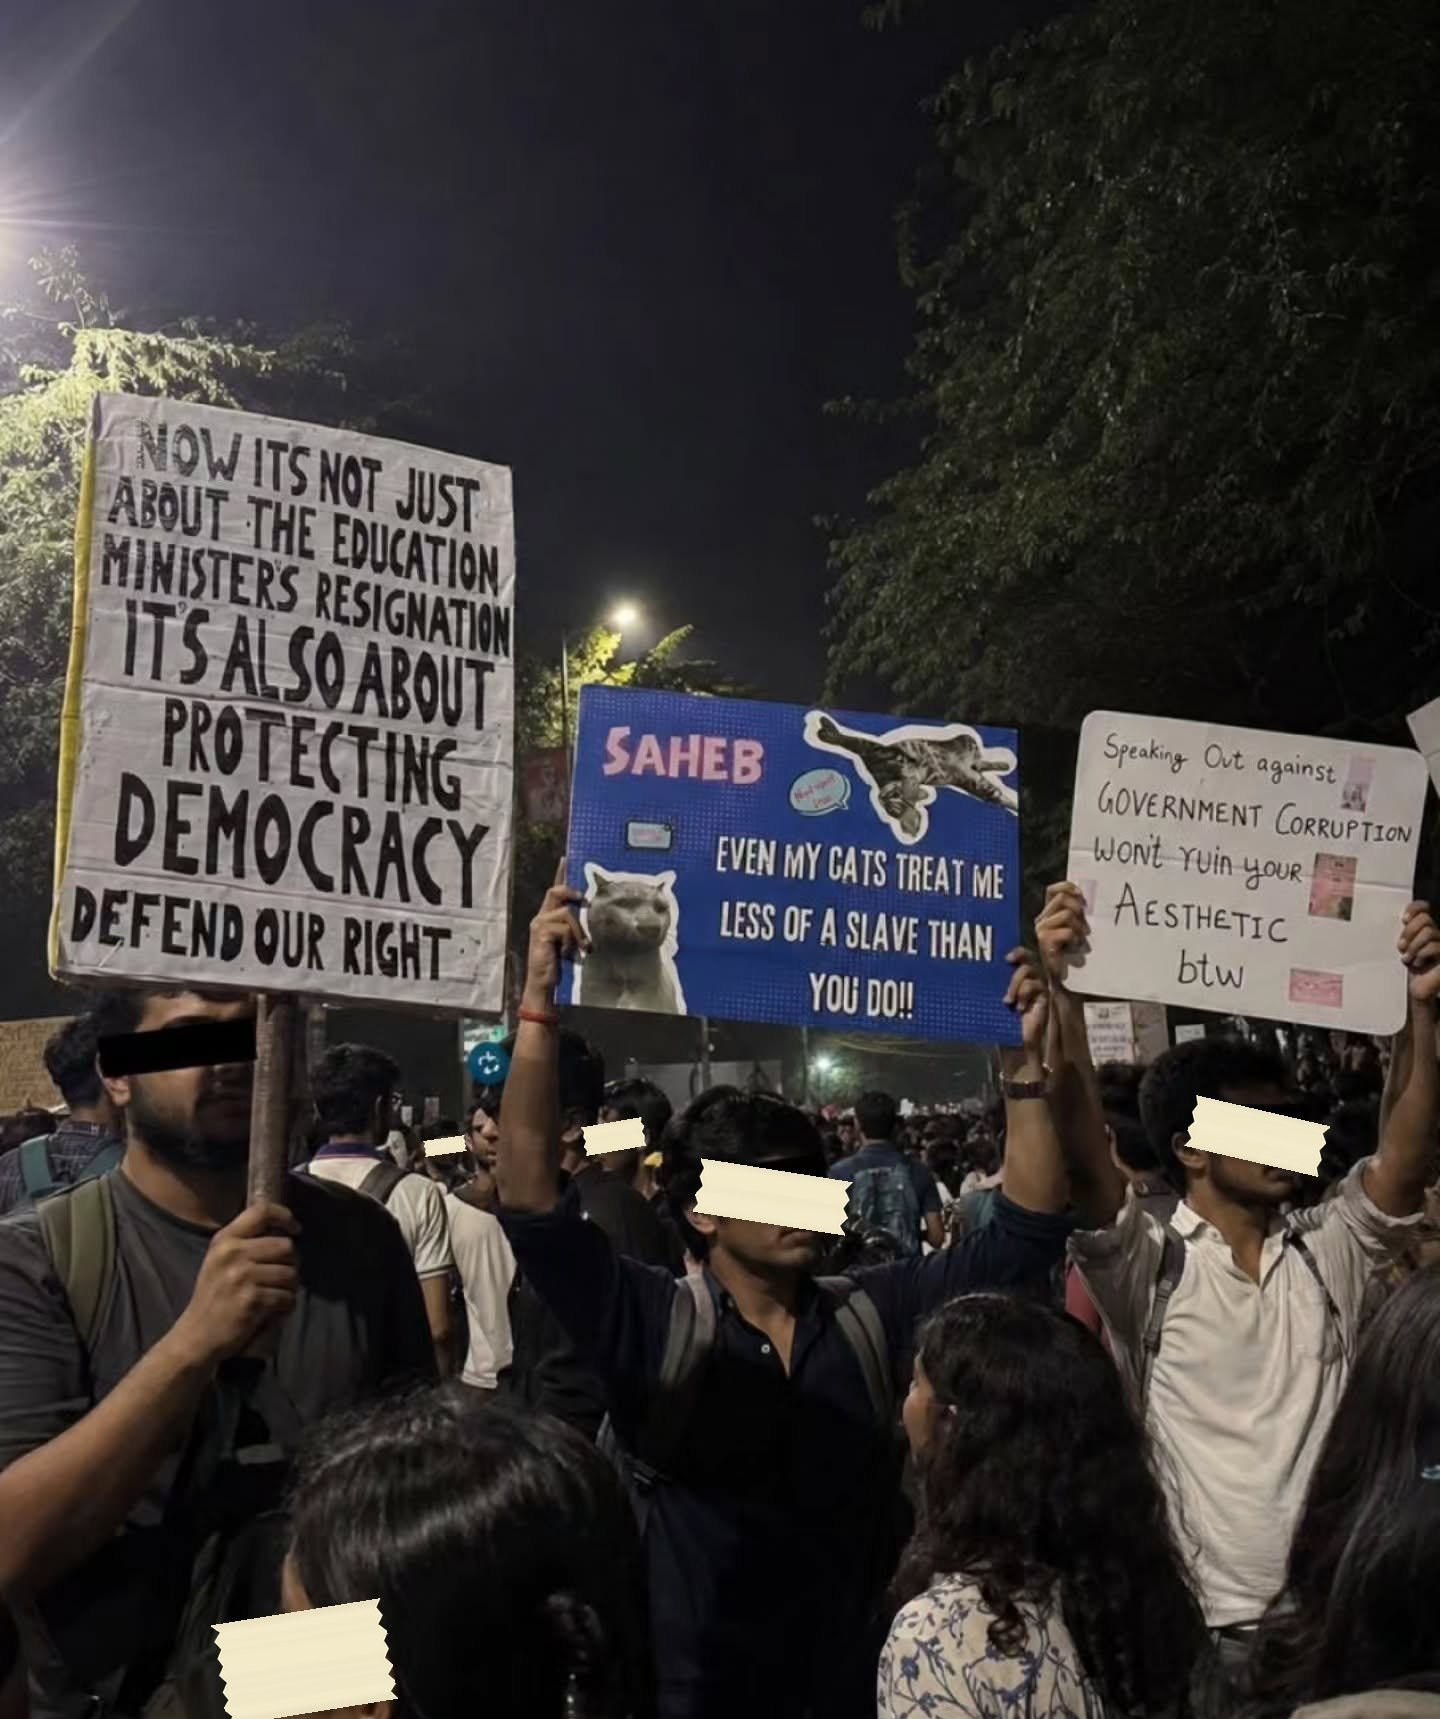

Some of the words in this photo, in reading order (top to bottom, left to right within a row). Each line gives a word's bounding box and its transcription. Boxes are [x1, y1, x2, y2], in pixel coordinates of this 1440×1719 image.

[136, 420, 242, 482] NOW
[254, 438, 311, 496] ITS
[320, 451, 382, 512] NOT
[396, 468, 480, 532] JUST
[107, 476, 229, 541] ABOUT
[247, 496, 317, 560] THE
[333, 513, 498, 597] EDUCATION
[316, 572, 510, 657] RESIGNATION
[220, 616, 345, 709] ALSO
[352, 642, 494, 731] ABOUT
[163, 697, 461, 811] PROTECTING
[602, 726, 764, 785] SAHEB
[1103, 733, 1188, 774] Speaking
[1204, 744, 1245, 770] Out
[1257, 755, 1338, 784] against
[114, 772, 489, 908] DEMOCRACY
[1098, 780, 1263, 828] GOVERNMENT
[1275, 802, 1412, 844] CORRUPTION
[716, 836, 775, 877] EVEN
[783, 844, 822, 880] MY
[831, 845, 886, 887] CATS
[896, 852, 964, 897] TREAT
[973, 864, 1004, 899] ME
[70, 886, 244, 961] DEFEND
[255, 908, 324, 970] OUR
[343, 917, 451, 980] RIGHT
[720, 902, 775, 941] LESS
[784, 906, 812, 943] OF
[821, 909, 837, 947] A
[846, 911, 919, 955] SLAVE
[928, 921, 993, 962] THAN
[1114, 882, 1288, 943] AESTHETIC
[809, 972, 858, 1013] YOU
[867, 979, 914, 1020] DO!!
[1177, 949, 1245, 989] btw
